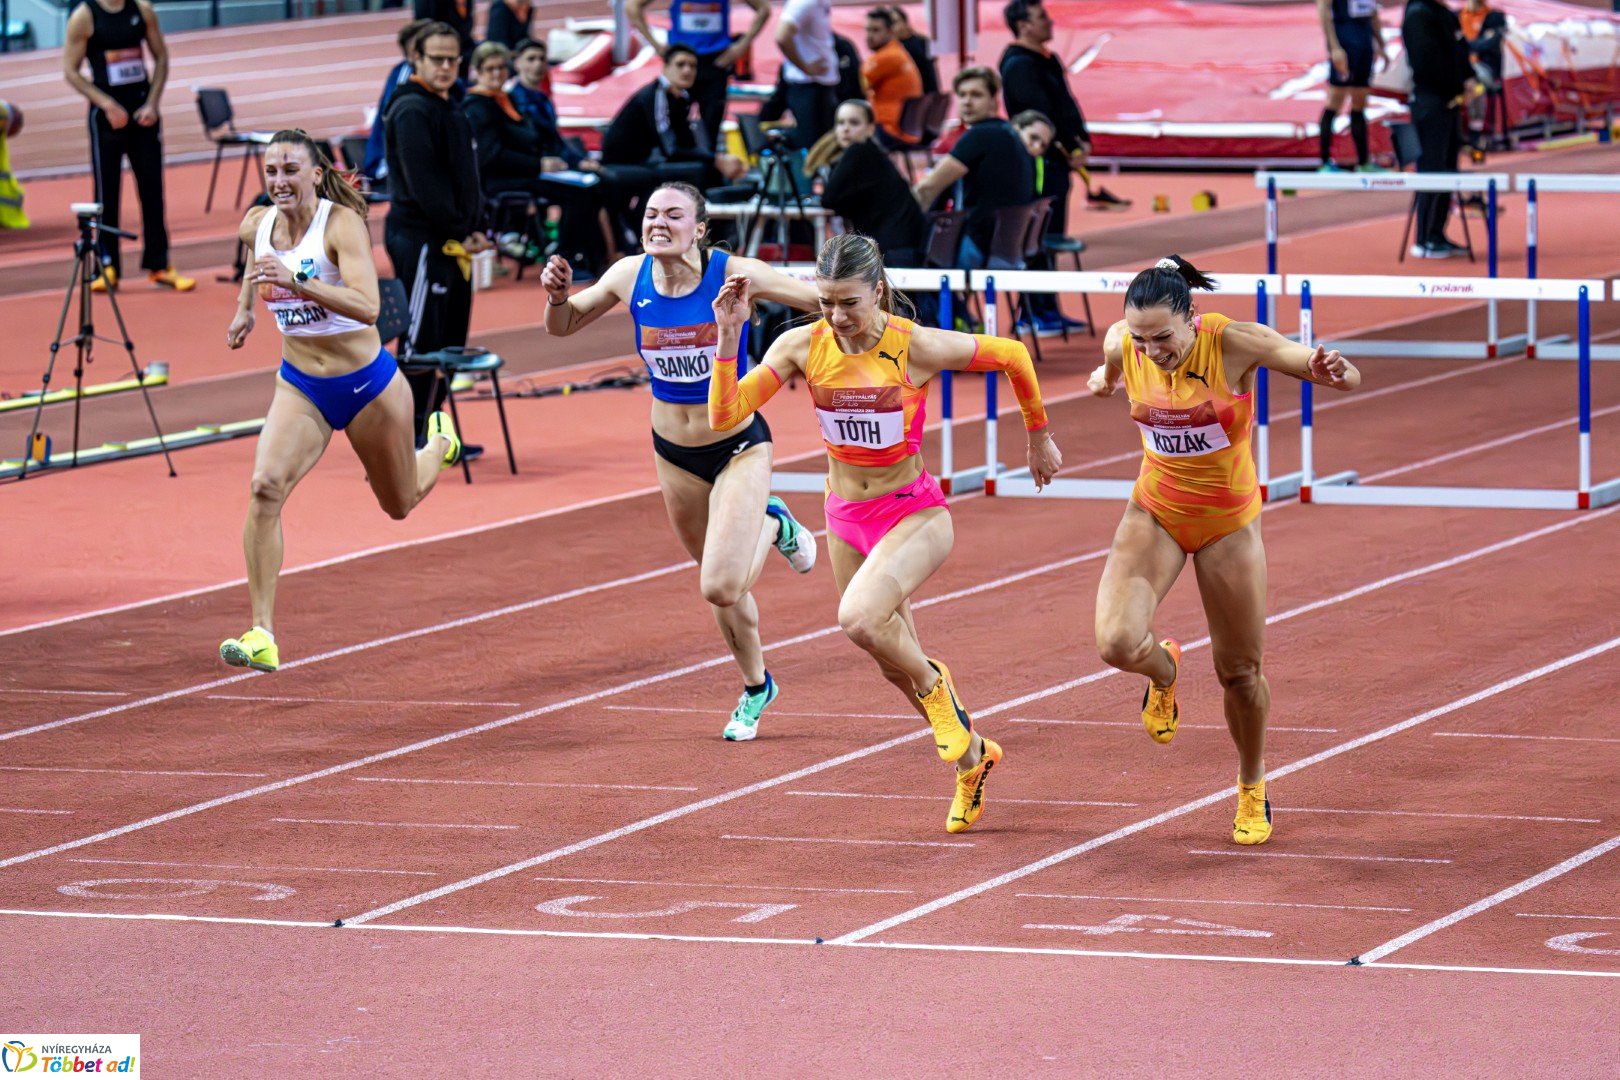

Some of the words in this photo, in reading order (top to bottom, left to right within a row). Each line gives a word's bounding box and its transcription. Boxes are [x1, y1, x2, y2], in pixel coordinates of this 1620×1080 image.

[1430, 283, 1474, 294] polanik
[655, 350, 710, 378] BANKÓ
[833, 415, 882, 445] TÓTH
[1152, 430, 1212, 453] KOZÁK
[534, 894, 800, 924] 5
